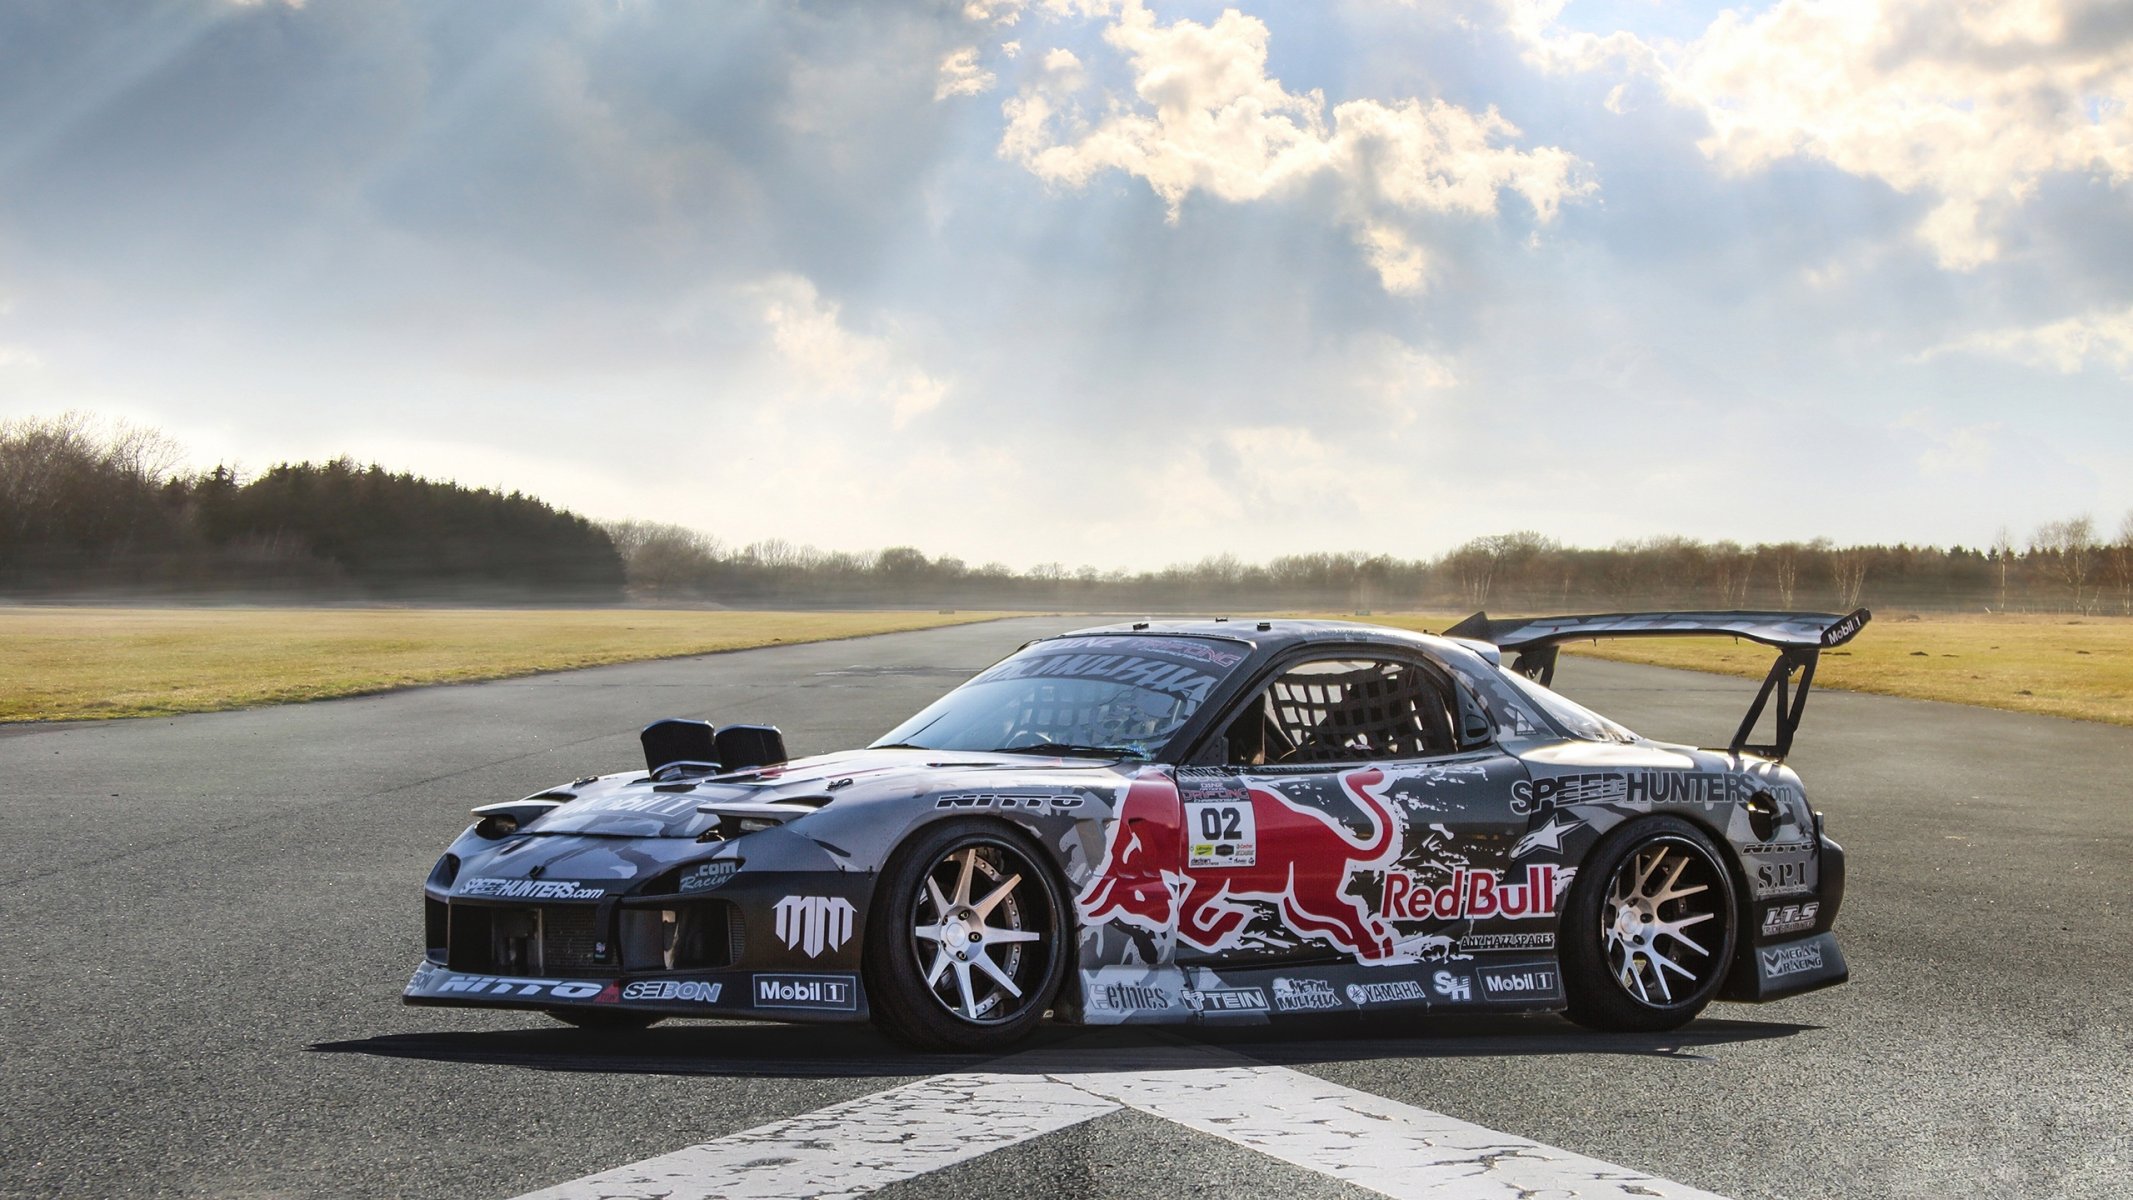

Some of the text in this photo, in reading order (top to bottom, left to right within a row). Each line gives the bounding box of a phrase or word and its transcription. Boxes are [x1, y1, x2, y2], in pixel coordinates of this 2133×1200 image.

[1828, 620, 1854, 645] Mobil
[935, 794, 1084, 809] NITTO
[1200, 808, 1242, 840] 02
[1381, 864, 1559, 920] Red Bull
[1485, 934, 1514, 946] MAZZ
[1514, 933, 1555, 945] SPARES
[1781, 945, 1821, 960] MEGAN
[1783, 958, 1823, 973] RACING
[437, 976, 602, 998] NITTO
[623, 981, 722, 1002] SEIBON
[760, 981, 820, 1000] Mobil
[1364, 981, 1426, 1002] YAMAHA
[1486, 973, 1534, 991] Mobil
[1106, 981, 1168, 1011] etnies
[1208, 991, 1266, 1008] TEIN
